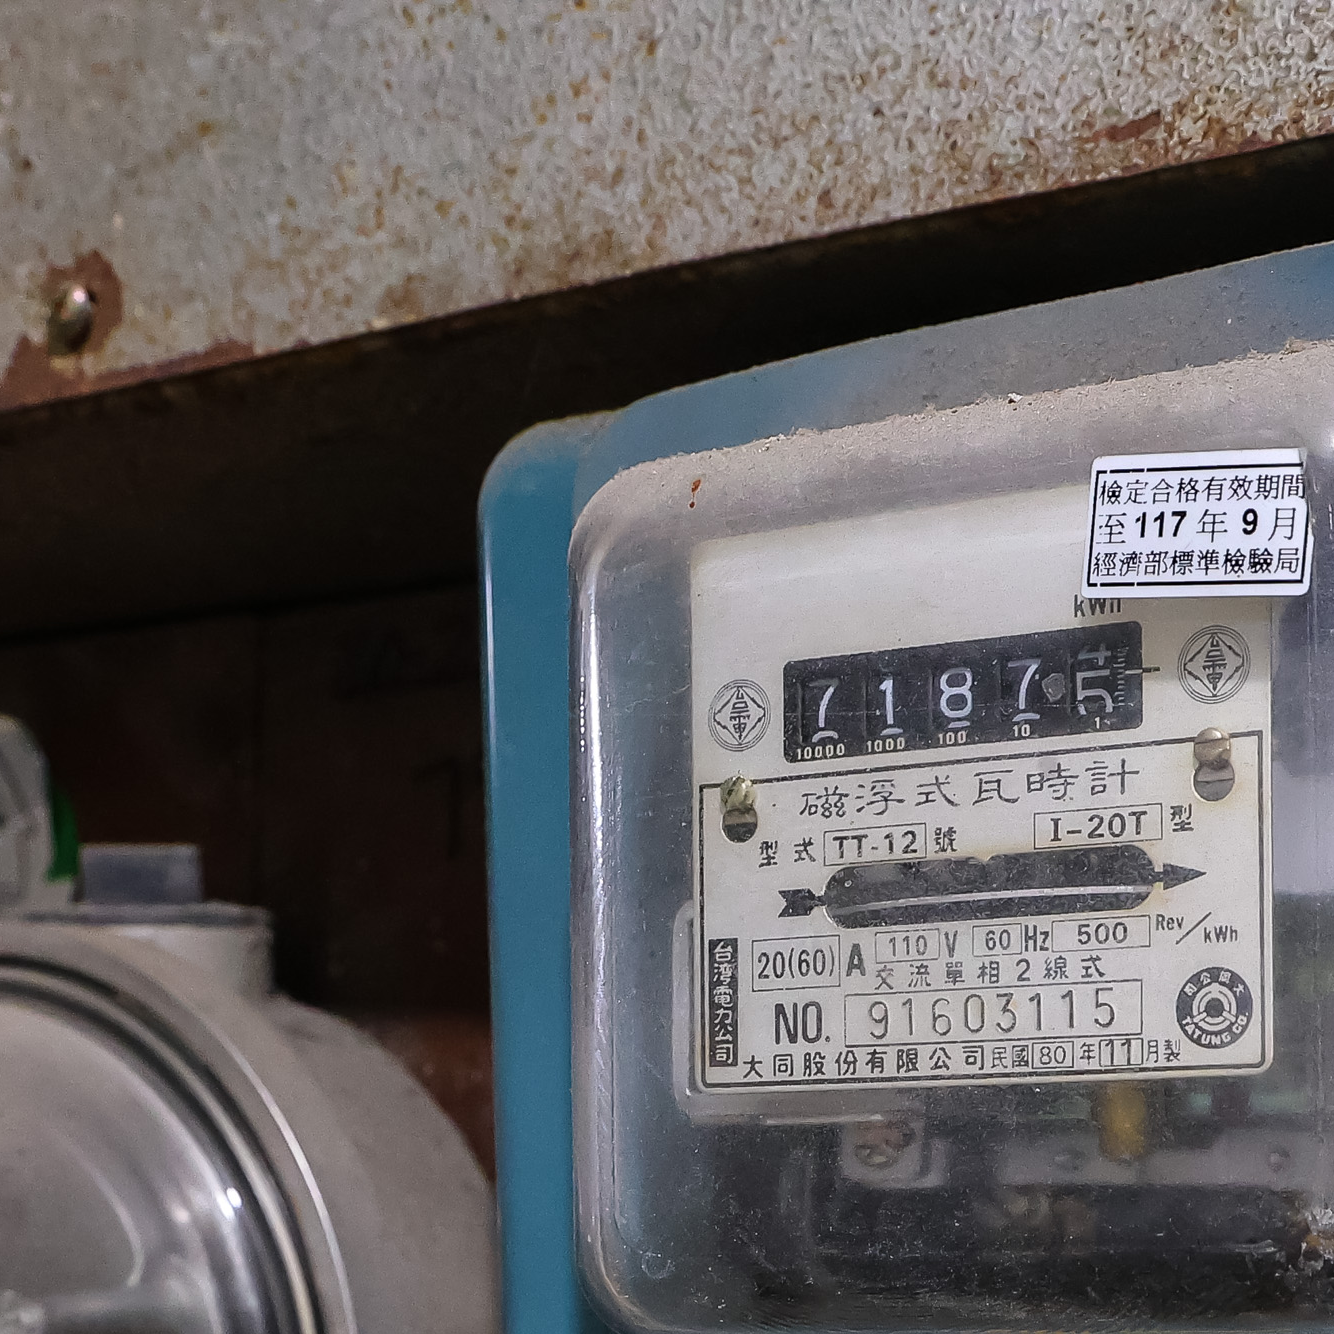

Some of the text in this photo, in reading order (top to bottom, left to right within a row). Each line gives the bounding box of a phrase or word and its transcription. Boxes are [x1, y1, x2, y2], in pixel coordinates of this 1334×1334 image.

[1098, 474, 1305, 506] 檢定合格有效期間
[1092, 548, 1300, 577] 經濟部標準檢驗局
[795, 743, 845, 760] 10000
[866, 736, 906, 753] 1000
[938, 730, 966, 746] 100
[1013, 723, 1031, 738] 10
[799, 758, 1140, 819] 磁浮式瓦時計
[832, 830, 919, 860] TT-12
[1049, 811, 1148, 842] I-20T
[1170, 804, 1194, 832] 型
[757, 945, 836, 979] 20(60)
[846, 943, 866, 977] A
[888, 934, 928, 958] 110
[944, 930, 958, 958] V
[984, 929, 1012, 951] 60
[1024, 924, 1050, 952] Hz
[1076, 921, 1128, 946] 500
[774, 987, 1116, 1045] NO. 91603115
[1182, 1016, 1232, 1046] TATUNG
